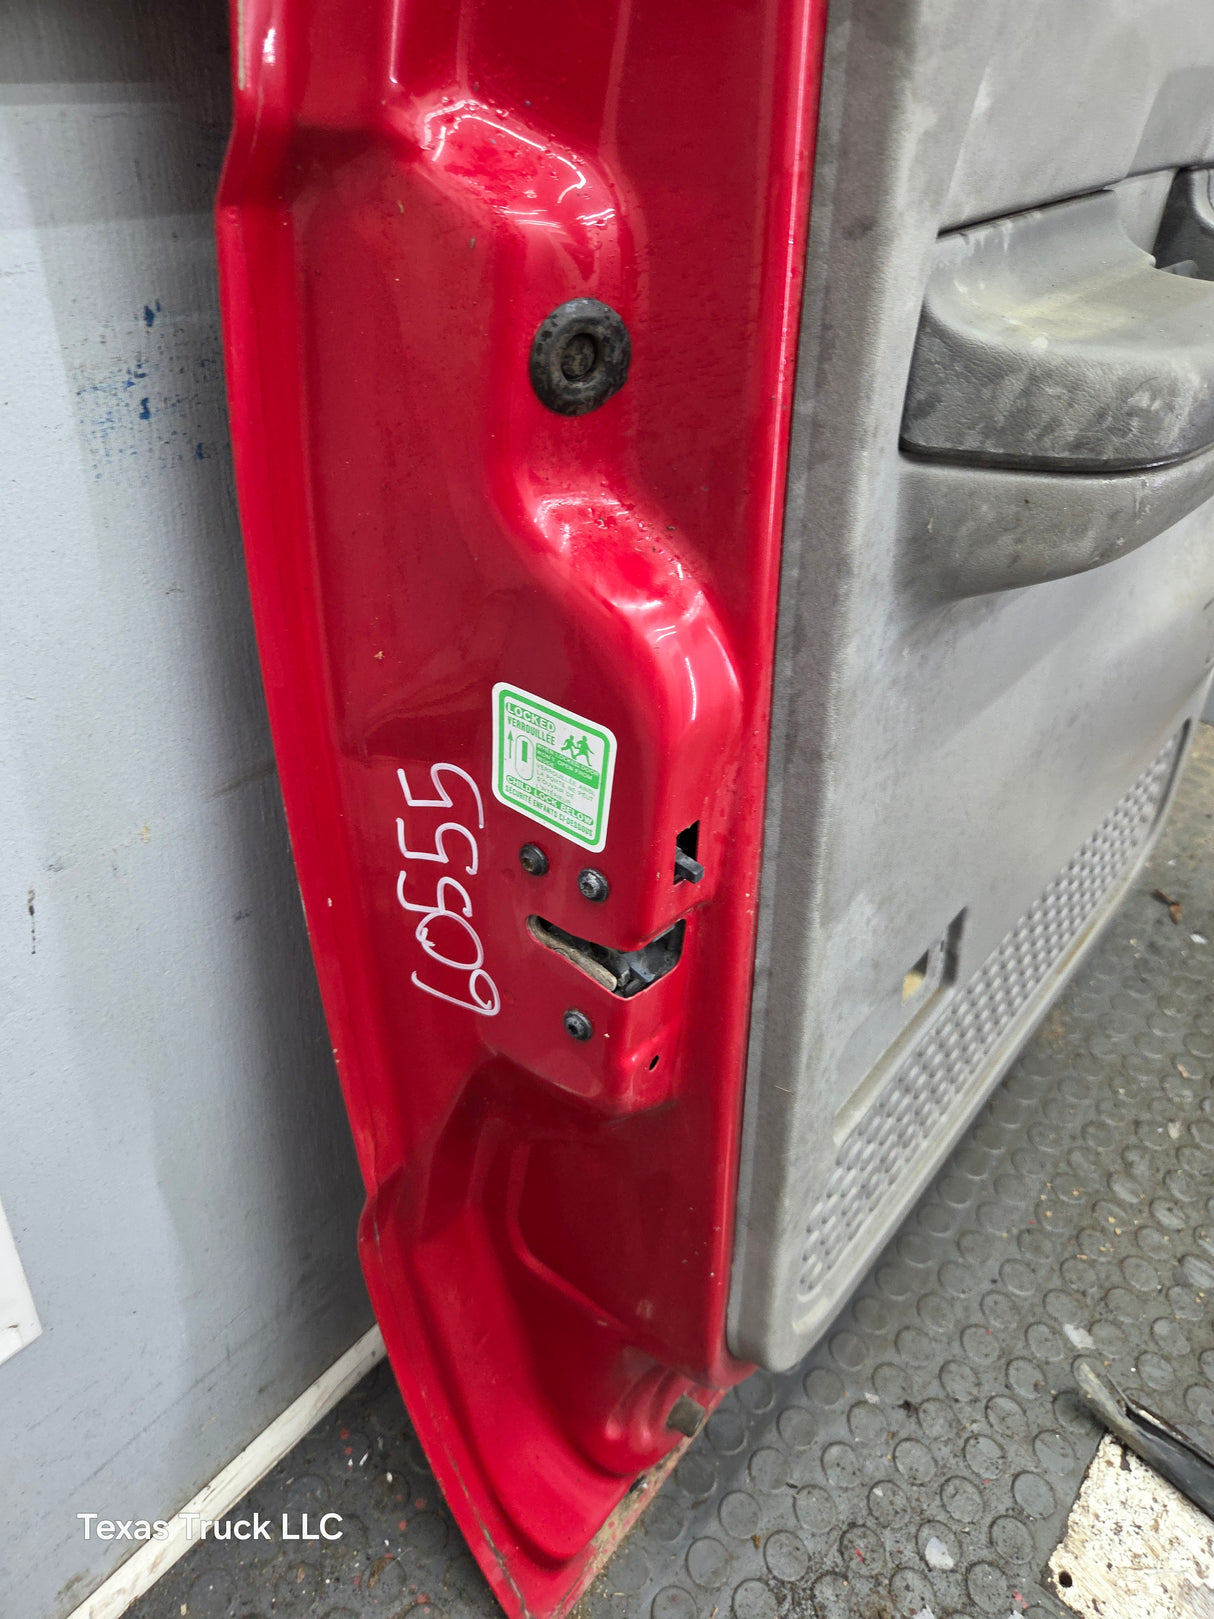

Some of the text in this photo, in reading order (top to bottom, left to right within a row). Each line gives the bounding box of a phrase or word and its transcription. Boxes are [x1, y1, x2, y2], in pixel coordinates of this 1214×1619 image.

[507, 702, 554, 732] LOCKED
[557, 759, 573, 771] OPEN
[574, 767, 592, 781] FROM
[506, 775, 592, 825] CHILD LOCK BELOW
[532, 798, 557, 818] ENFANTS
[577, 790, 593, 802] PEUT
[396, 762, 501, 1017] 60555
